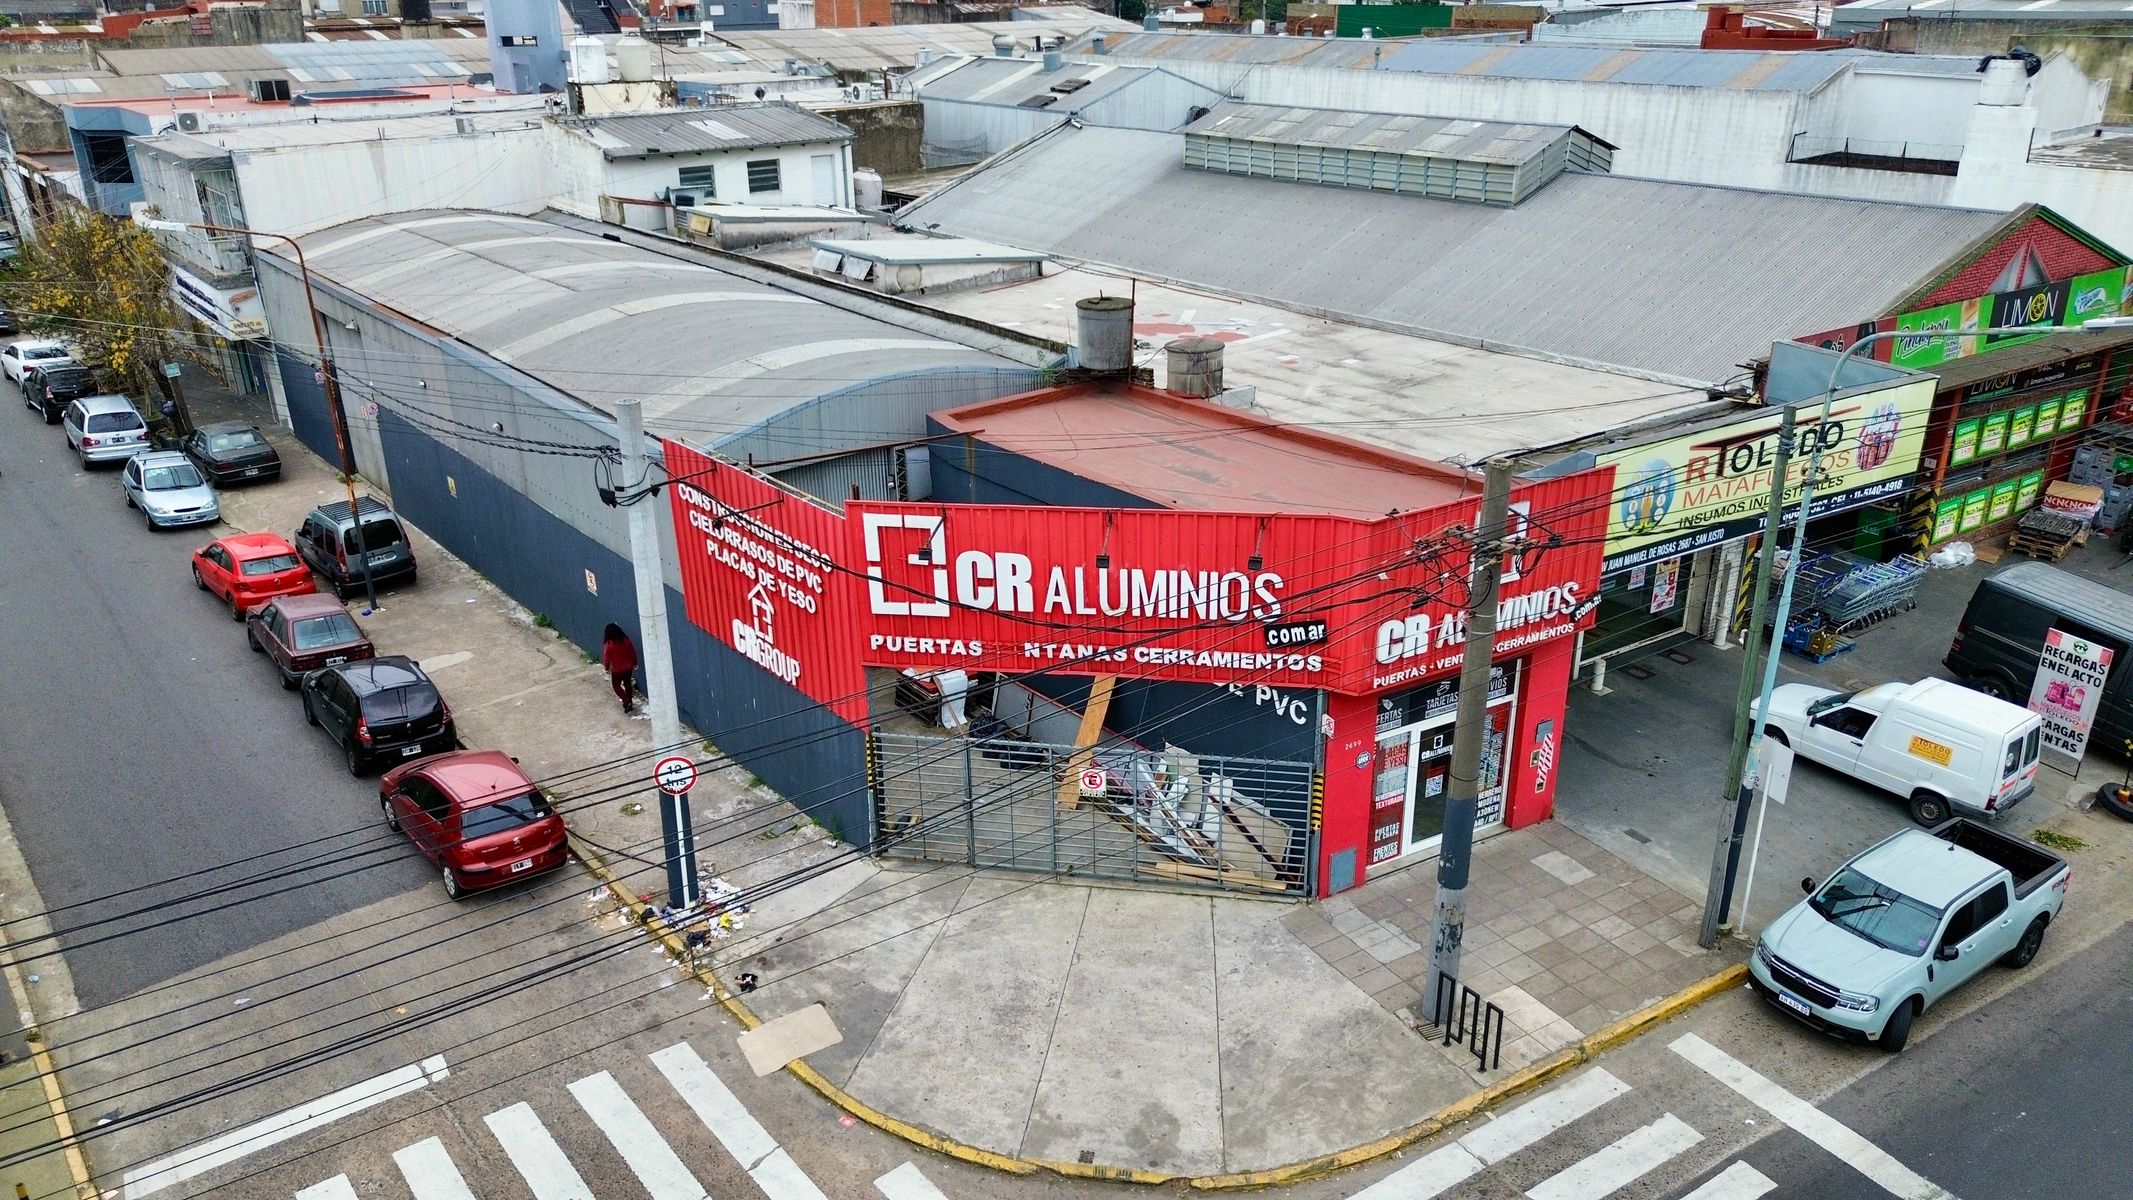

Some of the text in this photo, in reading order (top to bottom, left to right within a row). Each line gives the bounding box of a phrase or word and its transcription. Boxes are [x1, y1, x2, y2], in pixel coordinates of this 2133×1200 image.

[1679, 501, 1746, 528] INSUMOS
[1750, 475, 1845, 512] INDSTRALES
[689, 510, 823, 594] CIELORRASOS DE PVC
[1607, 558, 1623, 571] JUAN
[1624, 551, 1648, 565] MANUEL
[1648, 548, 1657, 559] DE
[1656, 544, 1676, 557] ROSAS
[1694, 534, 1708, 546] SAN
[1707, 528, 1725, 542] JUSTO
[706, 539, 816, 614] PLACAS DE YESO
[955, 549, 1285, 624] CR ALUMINIOS
[1375, 581, 1579, 665] CR ALMINIOS
[871, 634, 983, 657] PUERTAS
[1133, 646, 1323, 673] CERRAMIENTOS
[1373, 622, 1575, 689] PUERTAS VENT CERRAMIENTOS
[2045, 645, 2106, 675] RECARGAS
[2072, 669, 2102, 688] ACTO
[1255, 684, 1308, 725] PVC
[1376, 708, 1403, 726] FERTAS
[1426, 691, 1459, 710] TARJETAS
[1344, 739, 1362, 751] 2699
[667, 764, 682, 775] 12
